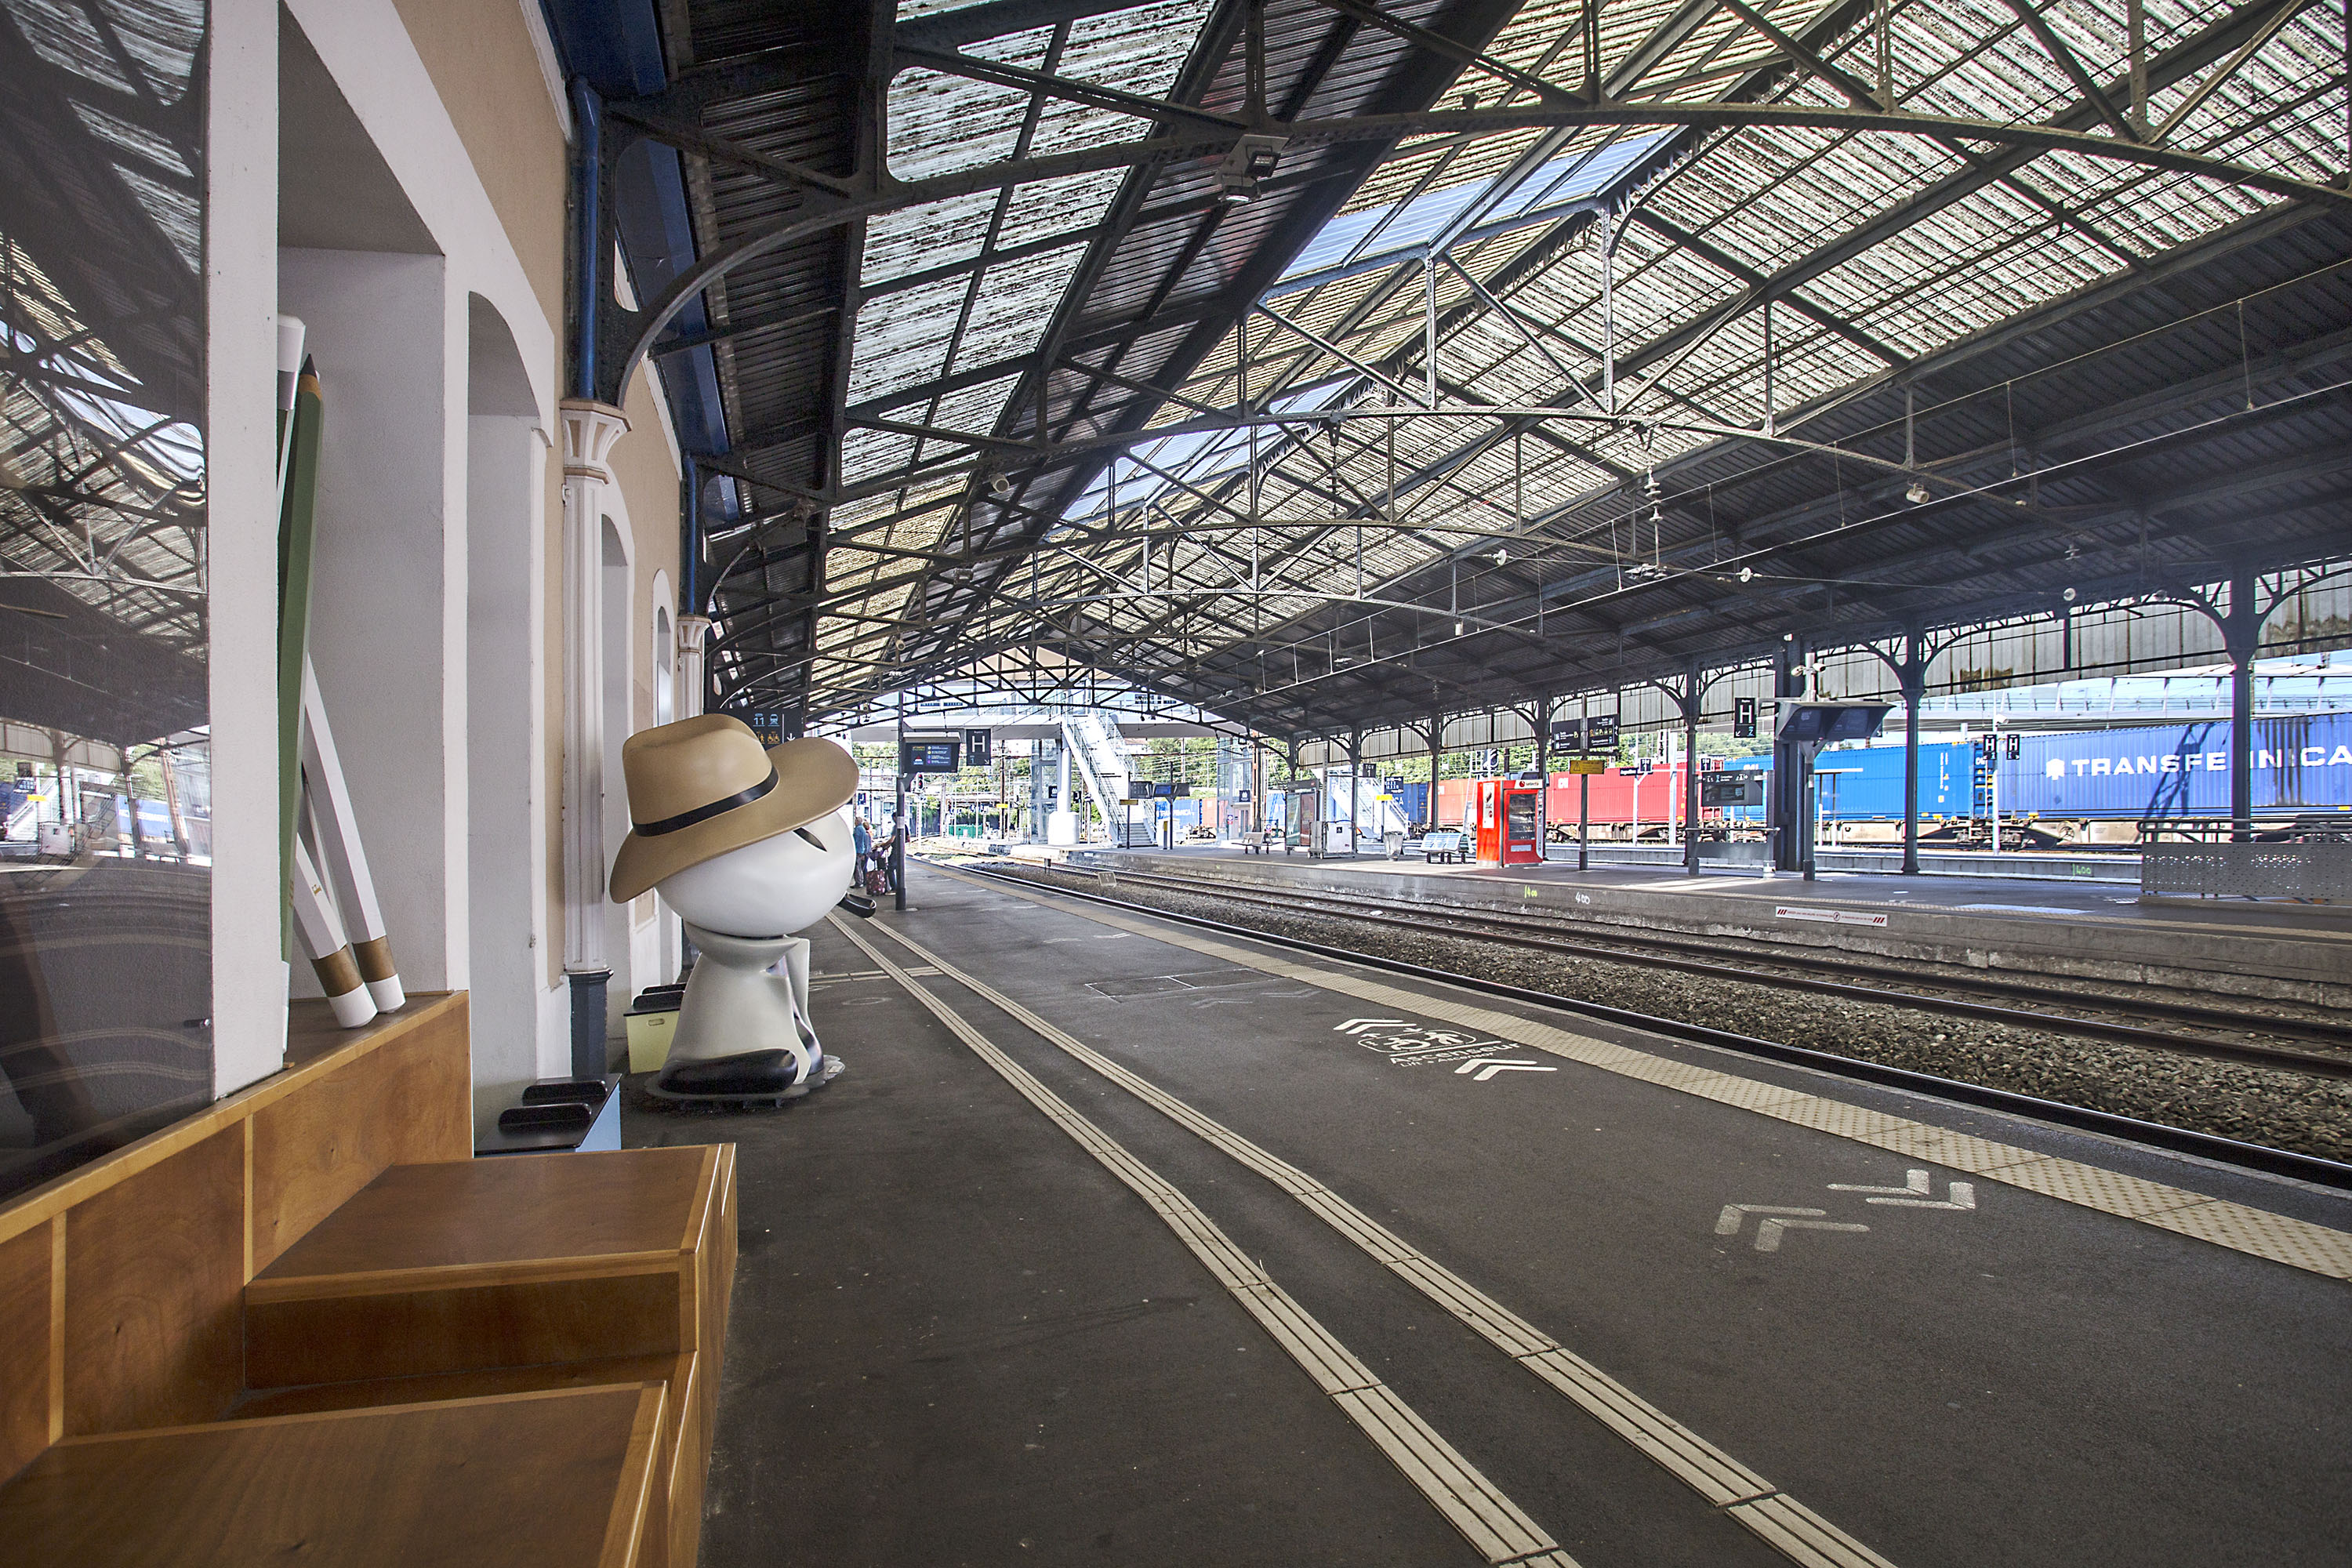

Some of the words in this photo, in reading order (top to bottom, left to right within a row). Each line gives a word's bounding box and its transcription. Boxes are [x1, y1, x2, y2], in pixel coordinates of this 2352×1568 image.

[1739, 704, 1753, 724] H
[753, 717, 764, 725] 11
[971, 735, 985, 753] H
[1985, 738, 1995, 751] H
[2008, 738, 2018, 751] H
[2071, 745, 2352, 777] TRANSFENICA
[1575, 891, 1590, 904] 400
[1389, 1043, 1520, 1065] Ascenseur
[1438, 1052, 1494, 1062] Ascensor
